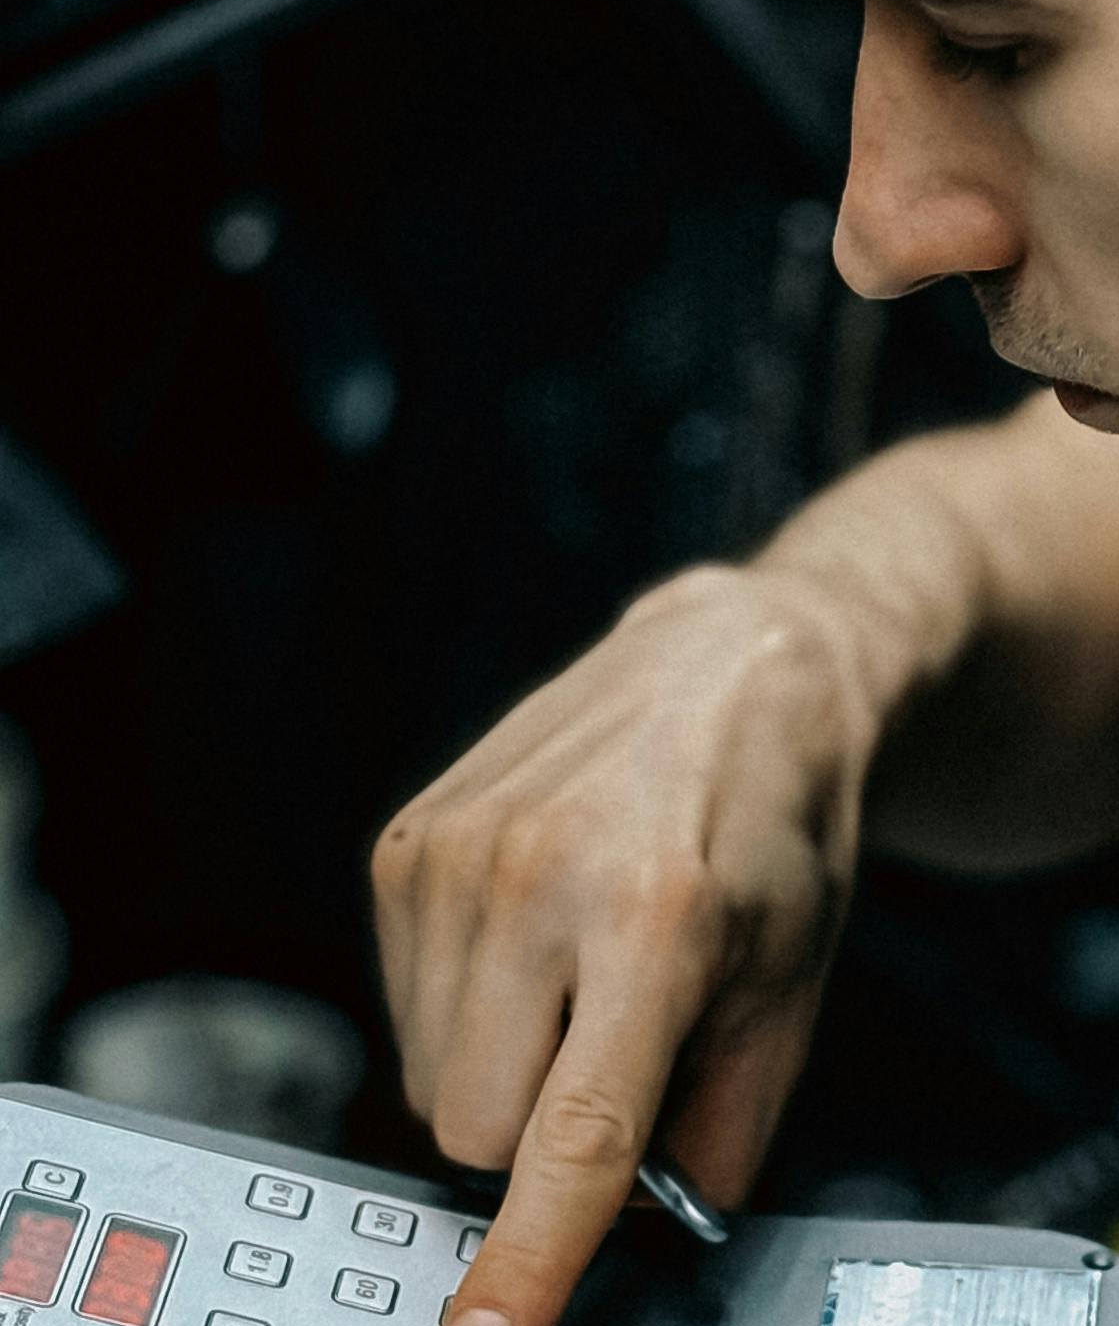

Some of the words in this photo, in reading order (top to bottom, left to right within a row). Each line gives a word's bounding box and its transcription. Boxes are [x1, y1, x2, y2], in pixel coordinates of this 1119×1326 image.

[44, 1171, 66, 1185] C
[268, 1182, 294, 1208] 0.9
[374, 1211, 398, 1231] 30
[247, 1249, 273, 1274] 1.8
[355, 1279, 379, 1299] 60
